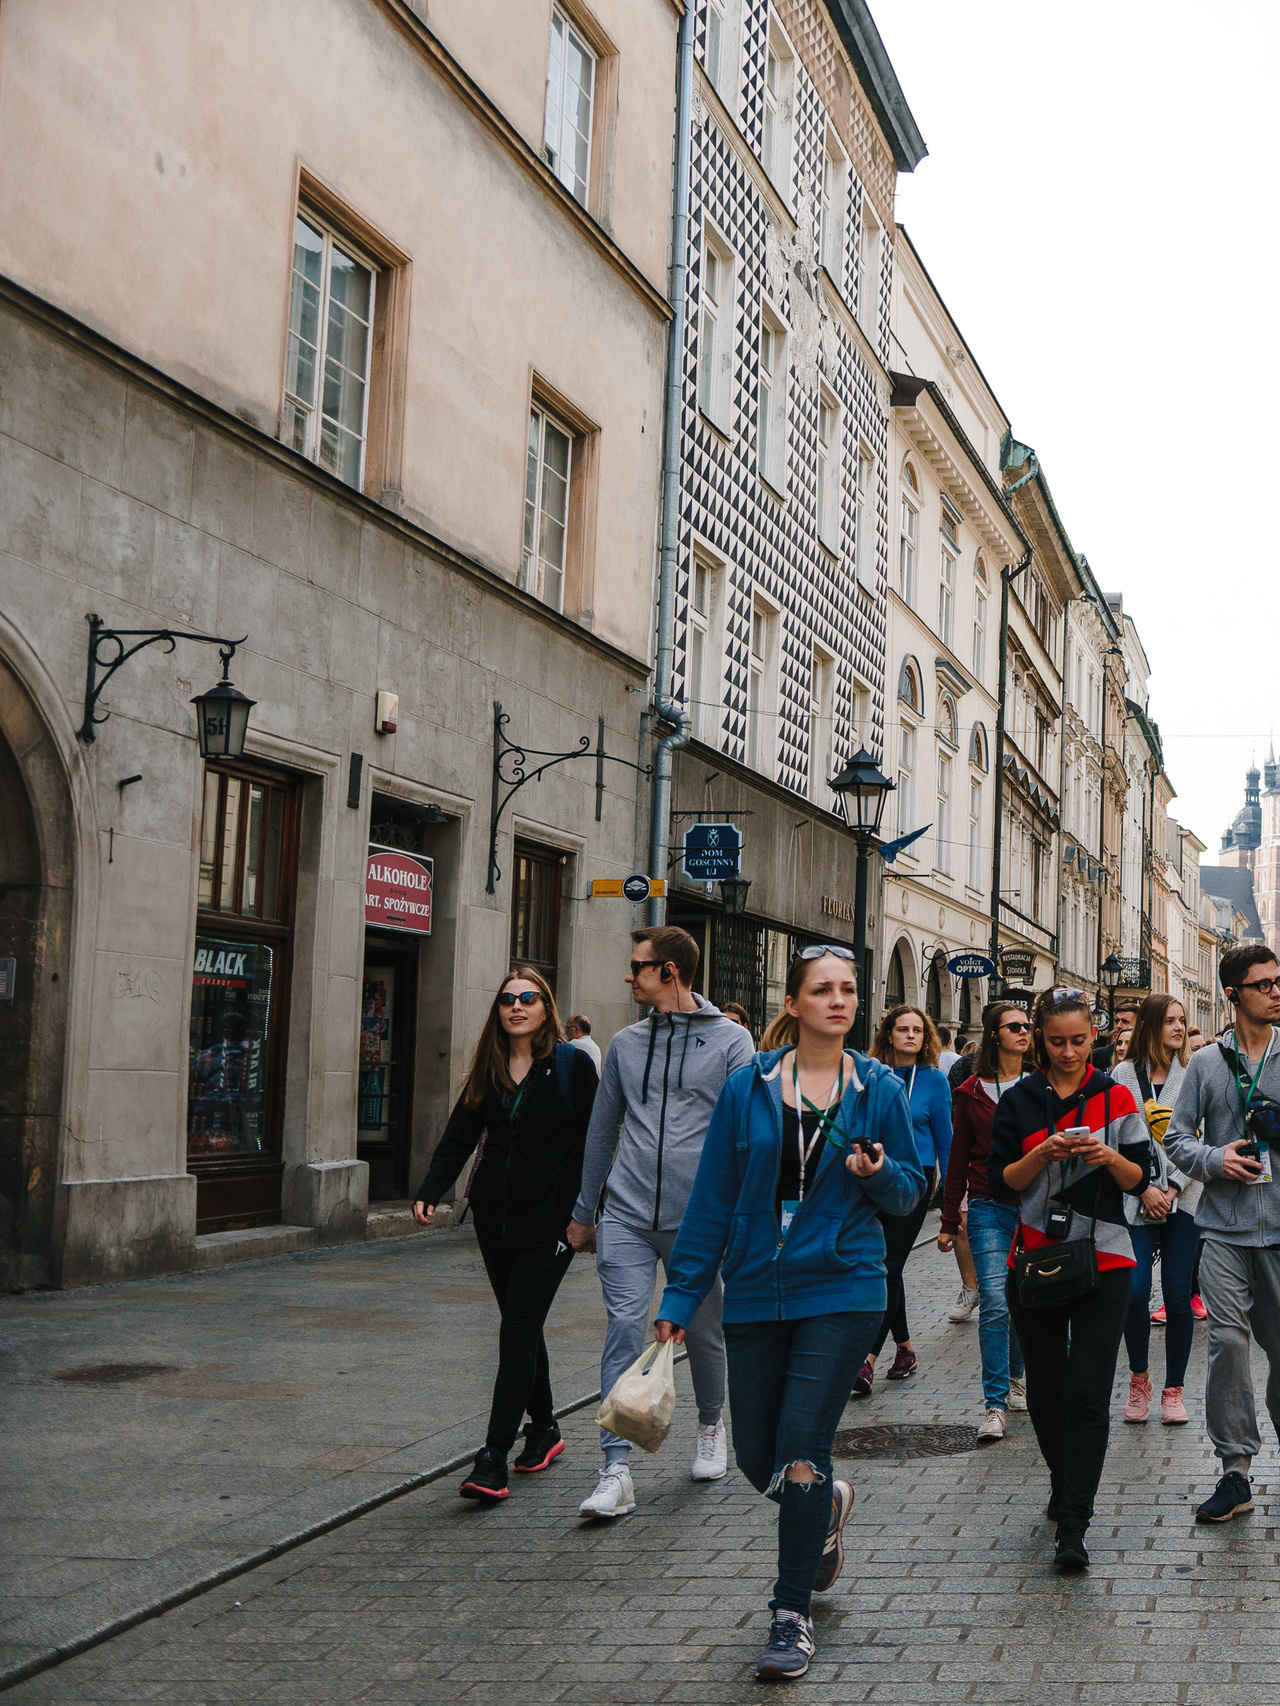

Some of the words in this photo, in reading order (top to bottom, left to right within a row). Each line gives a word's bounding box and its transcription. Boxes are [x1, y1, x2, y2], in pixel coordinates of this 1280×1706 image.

[207, 718, 224, 735] 51
[368, 863, 428, 891] ALKOHOLE
[706, 868, 717, 876] UJ
[383, 896, 430, 917] SPOŻYWCZE
[194, 948, 248, 976] BLACK
[955, 965, 985, 974] OPTYK
[960, 957, 983, 966] VOIGT
